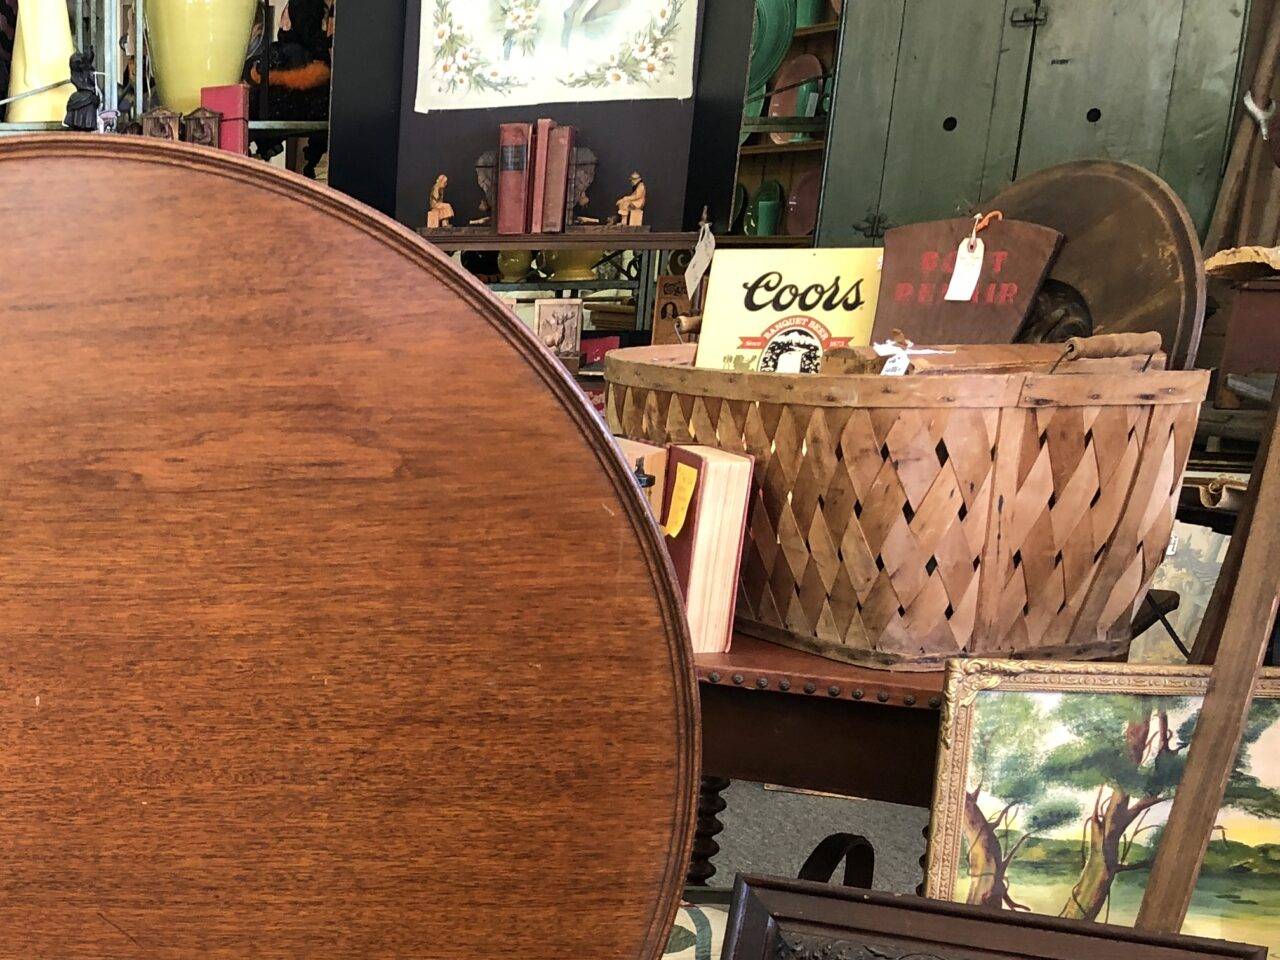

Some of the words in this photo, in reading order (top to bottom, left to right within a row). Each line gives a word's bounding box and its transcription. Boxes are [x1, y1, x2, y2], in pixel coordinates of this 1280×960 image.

[742, 271, 865, 312] Coors
[764, 317, 809, 340] BANQUET
[808, 319, 829, 341] BEER
